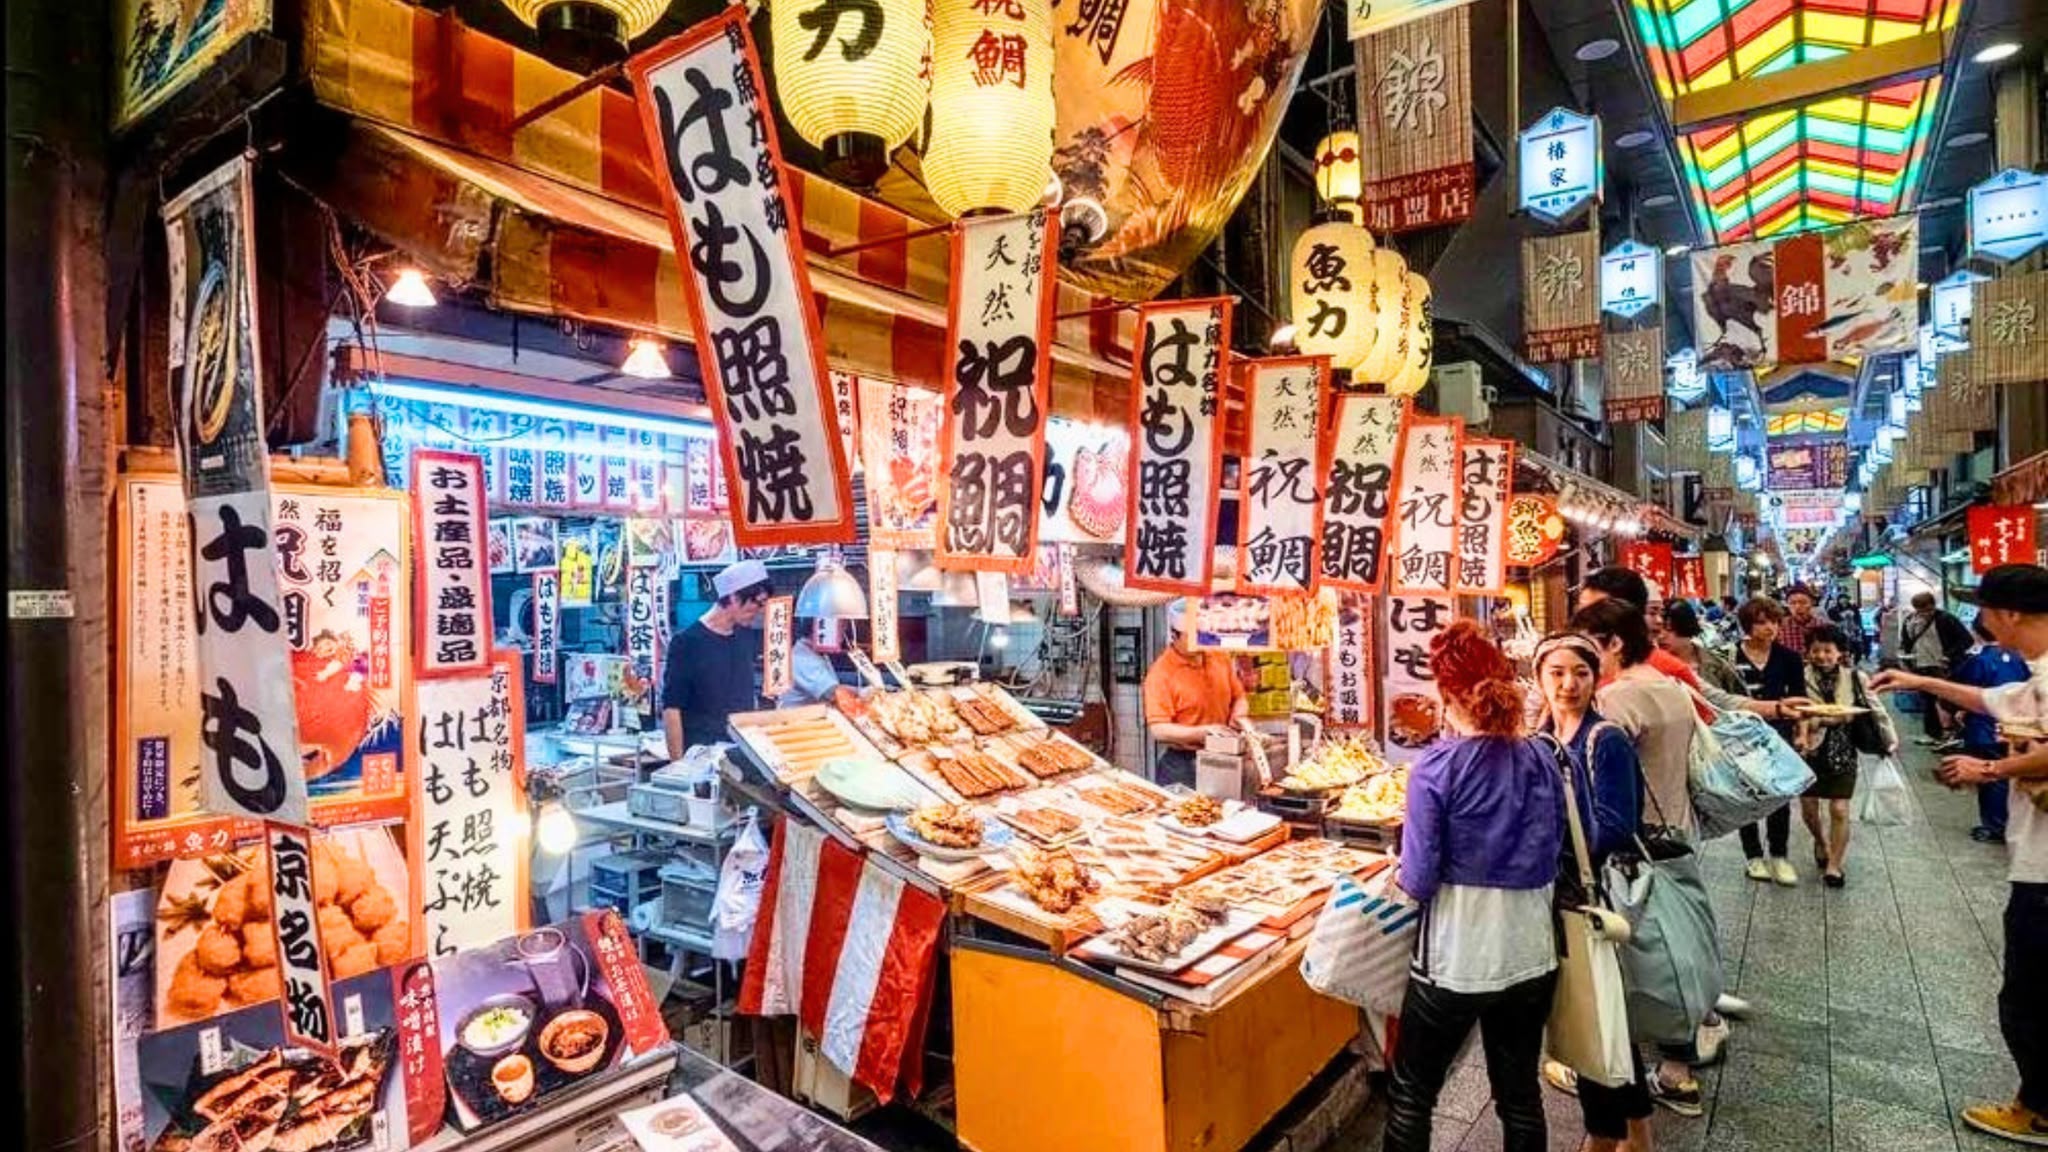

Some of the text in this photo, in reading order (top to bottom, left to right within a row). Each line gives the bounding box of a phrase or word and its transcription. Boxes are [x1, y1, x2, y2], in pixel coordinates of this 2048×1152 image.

[1370, 187, 1471, 230] 加盟店
[1547, 141, 1568, 188] 椿家
[653, 67, 814, 523] はも照焼
[984, 234, 1017, 328] 天然
[1302, 243, 1353, 340] 魚力
[1779, 281, 1821, 319] 錦
[945, 336, 1040, 556] 祝鯛
[1135, 316, 1198, 580] はも照焼
[313, 506, 343, 608] 福を招く
[429, 465, 478, 664] お土産品・最適品
[1243, 448, 1321, 592] 祝鯛
[1319, 458, 1393, 586] 祝鯛
[1398, 484, 1457, 590] 祝鯛
[1459, 448, 1496, 588] はも照焼
[189, 503, 287, 815] はも
[487, 669, 515, 773] 京都名物
[181, 828, 230, 854] 魚力
[418, 706, 463, 955] はも天ぷら
[457, 705, 501, 914] はも照焼
[271, 833, 330, 1047] 京名物
[399, 987, 425, 1077] 味噌漬け
